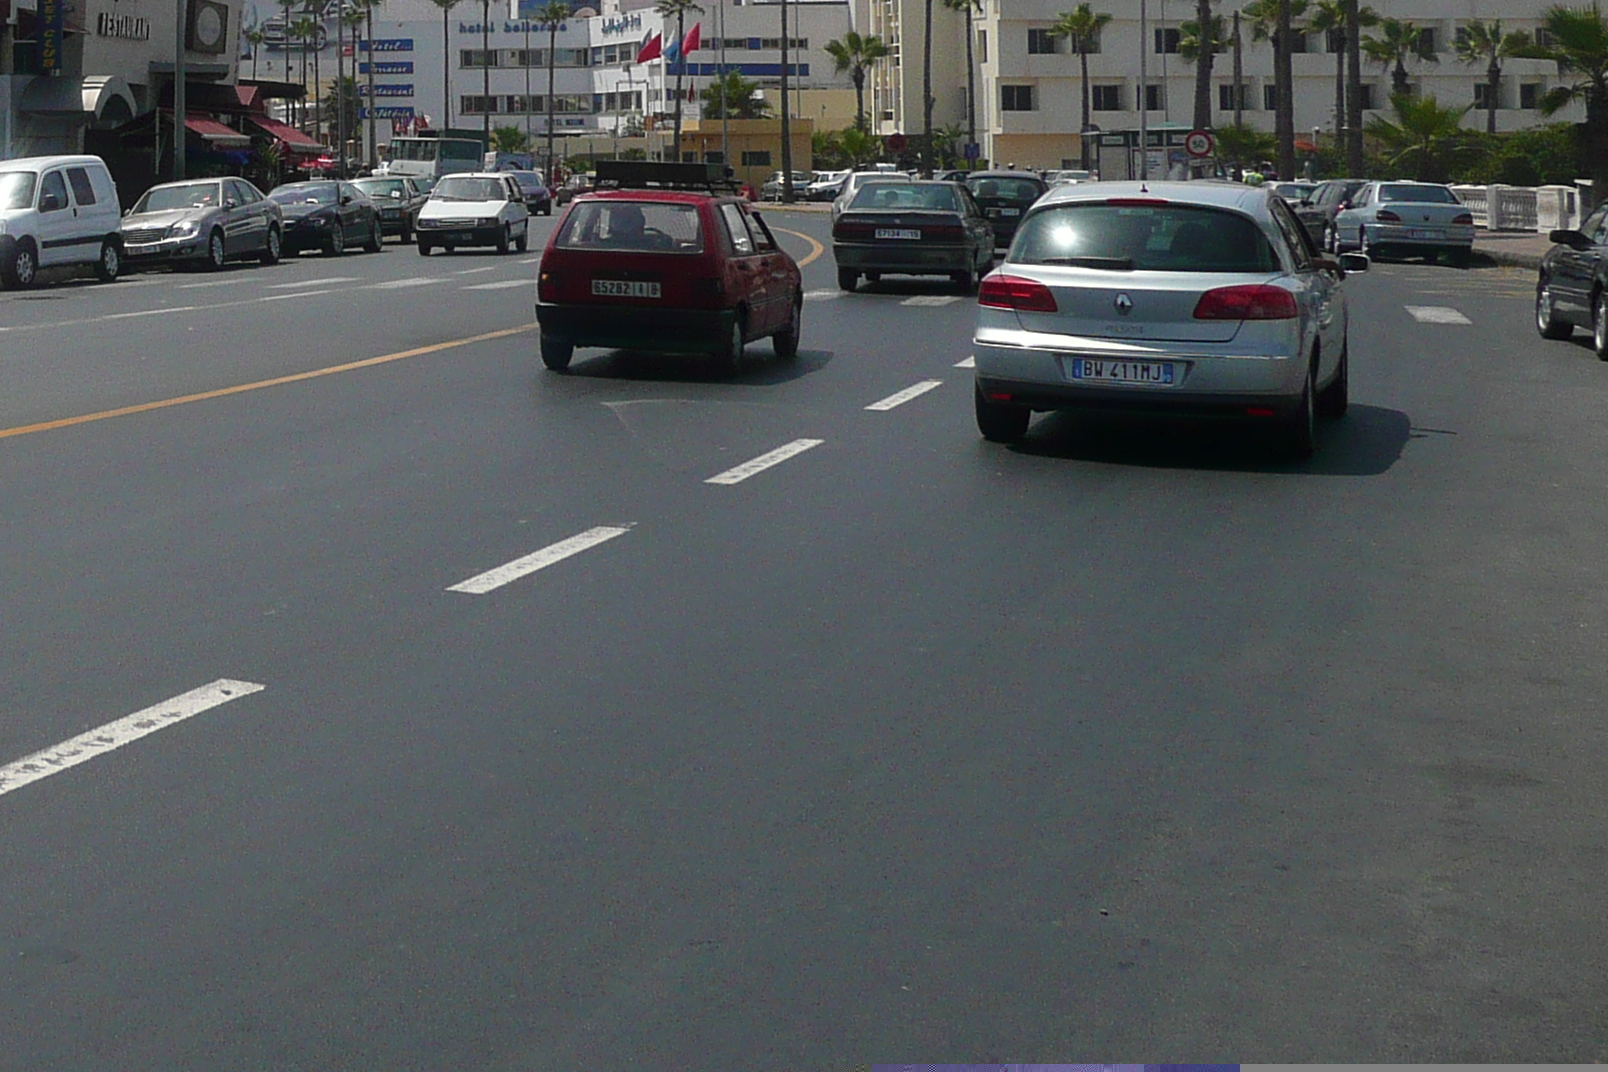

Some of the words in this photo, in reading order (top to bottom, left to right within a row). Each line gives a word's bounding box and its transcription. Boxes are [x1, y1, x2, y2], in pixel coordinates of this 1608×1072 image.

[97, 12, 150, 41] RESTAURANT
[459, 21, 495, 34] hotl
[42, 29, 56, 68] CLUB
[1192, 138, 1205, 149] 50
[1083, 361, 1104, 378] BW
[1109, 363, 1162, 381] 411MJ
